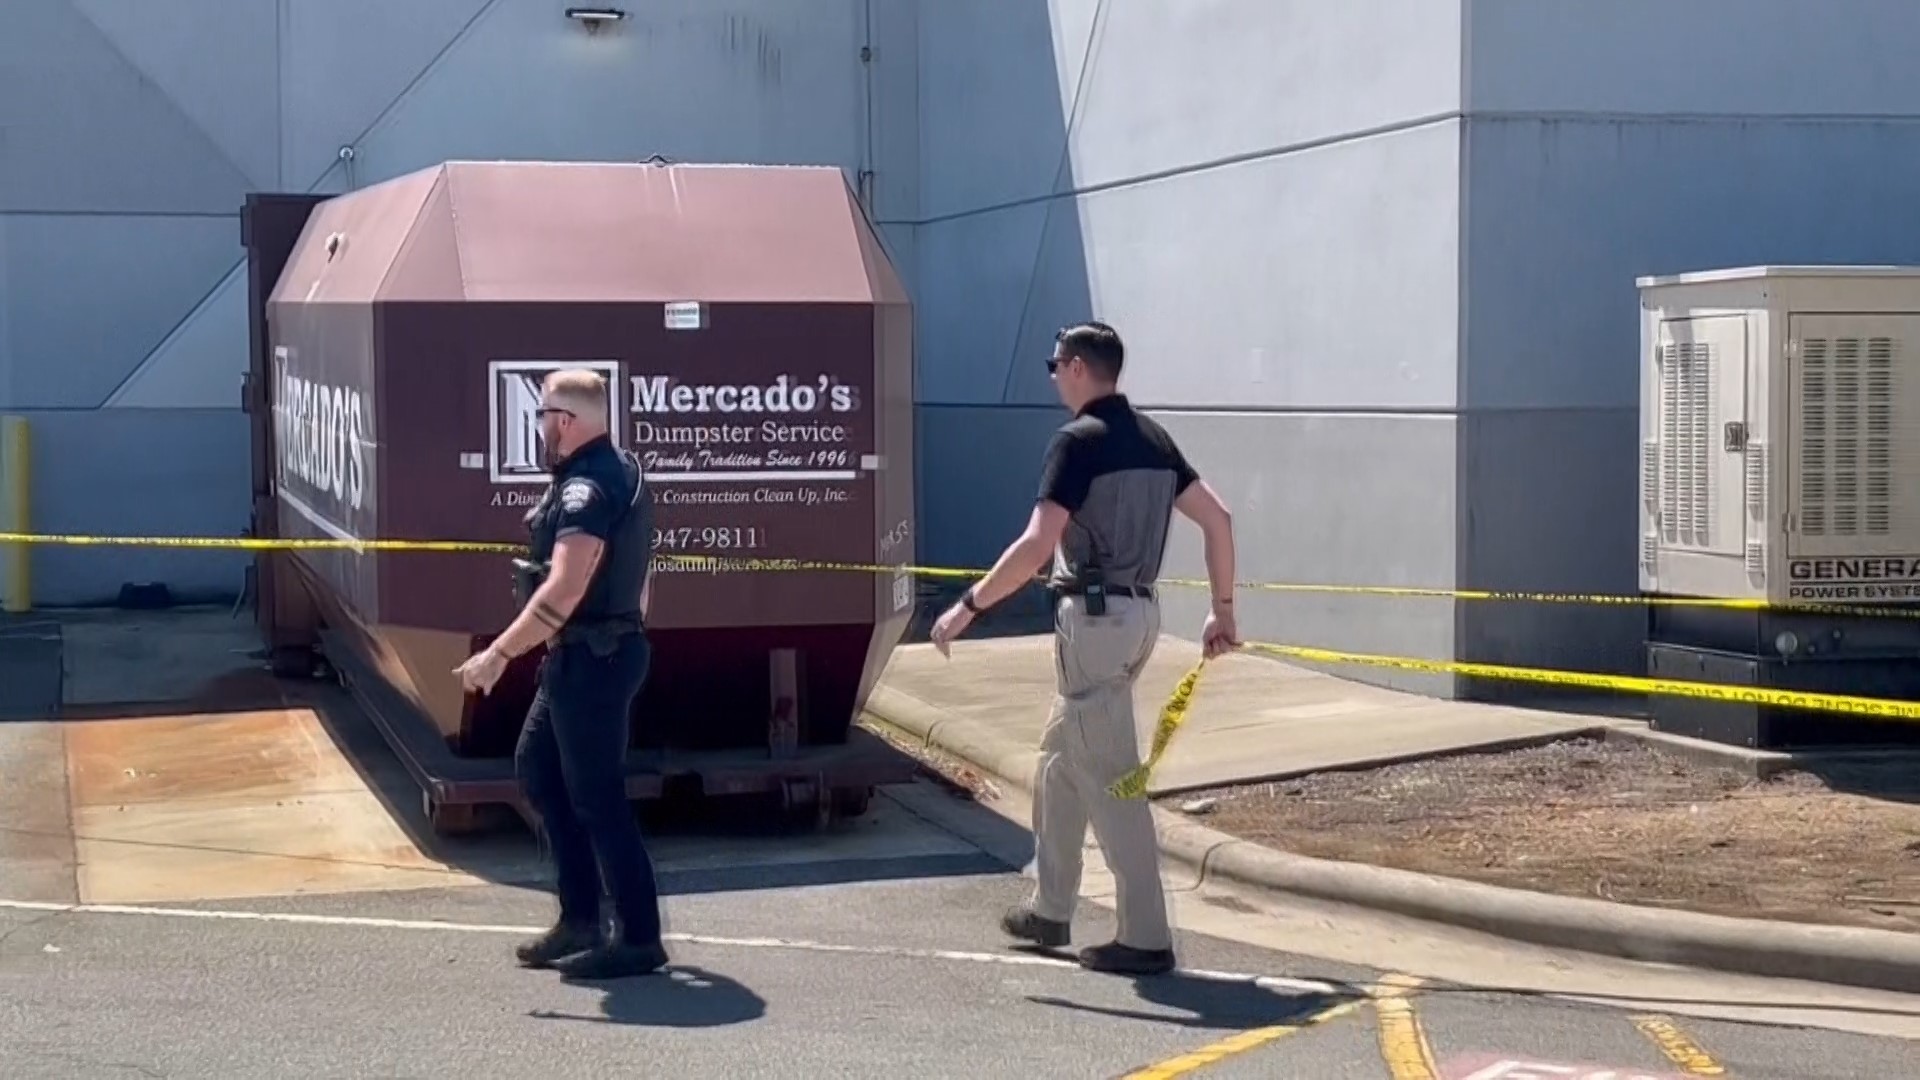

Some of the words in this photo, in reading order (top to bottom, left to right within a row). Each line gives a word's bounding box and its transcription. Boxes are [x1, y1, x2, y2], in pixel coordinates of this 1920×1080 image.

[630, 374, 851, 413] Mercado's
[635, 420, 754, 448] Dumpster
[761, 420, 844, 442] Service
[643, 450, 693, 471] Family
[698, 449, 762, 468] Tradition
[765, 449, 802, 467] Since
[807, 449, 848, 467] 1996
[490, 491, 502, 506] A
[663, 488, 750, 504] Construction
[754, 487, 795, 503] Clean
[798, 487, 821, 506] Up,
[1789, 586, 1859, 599] POWER
